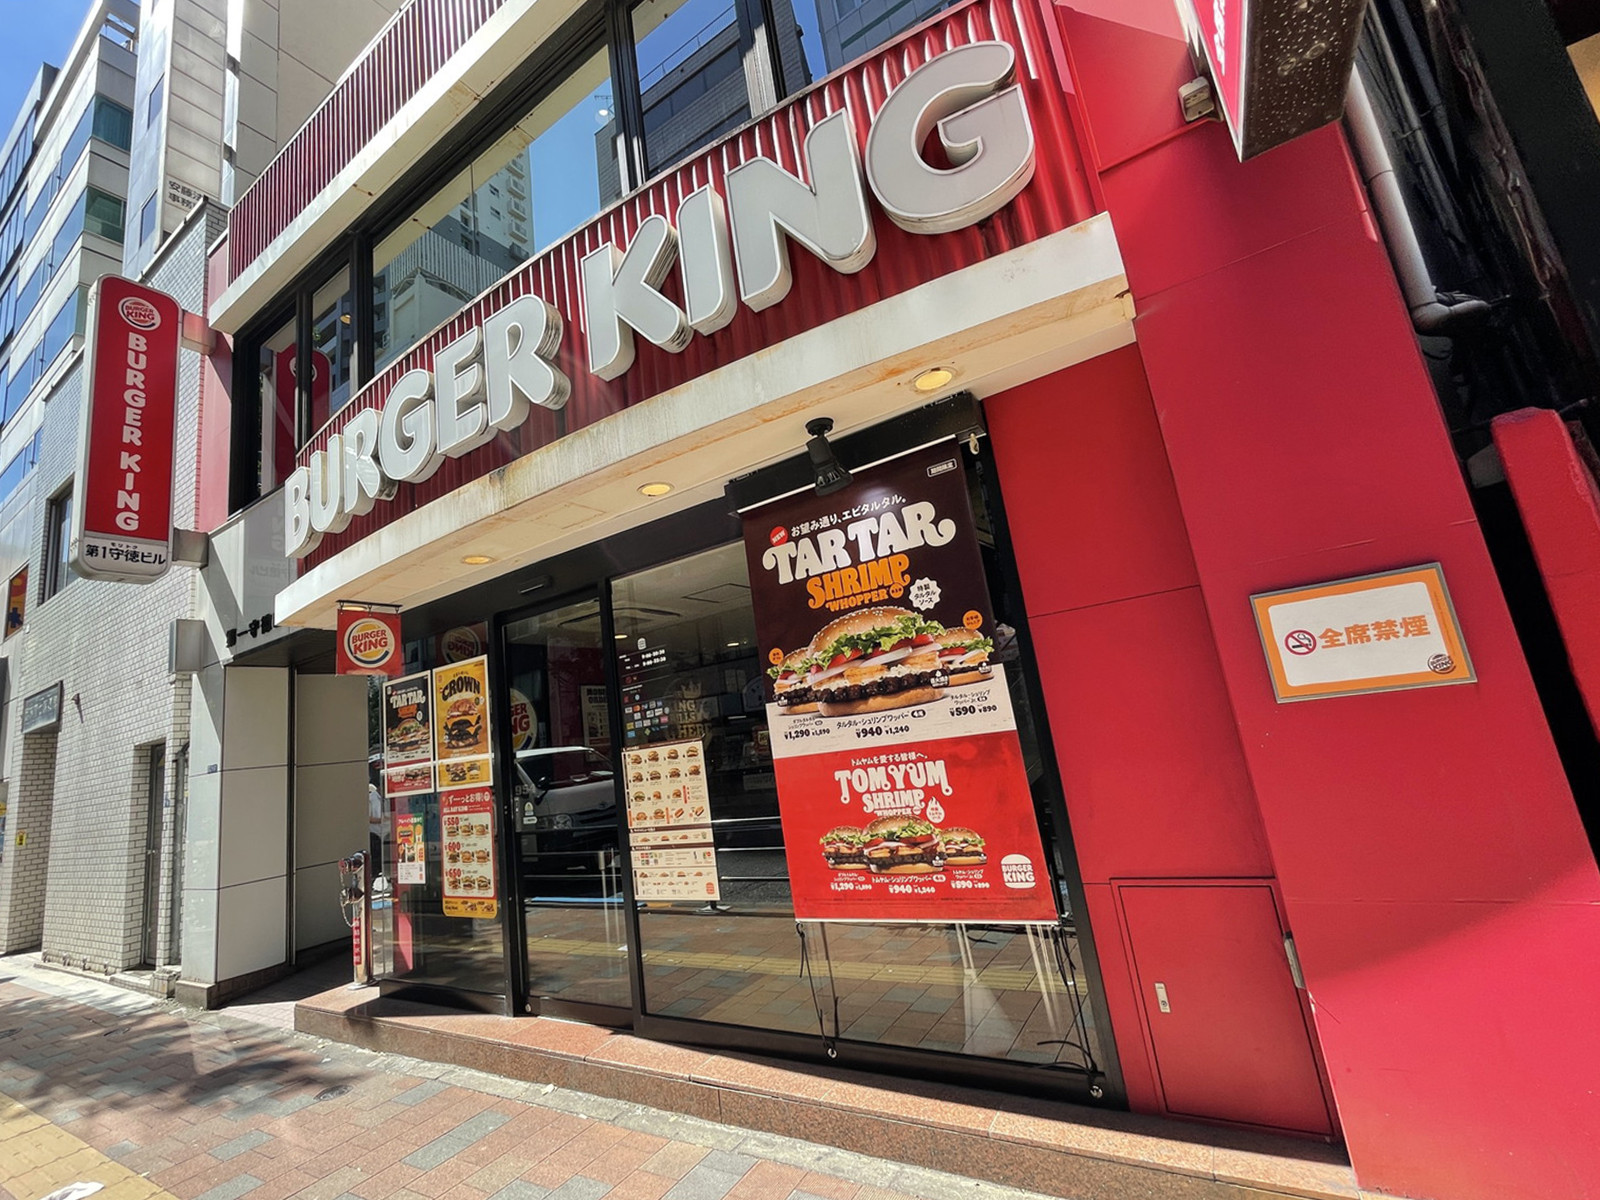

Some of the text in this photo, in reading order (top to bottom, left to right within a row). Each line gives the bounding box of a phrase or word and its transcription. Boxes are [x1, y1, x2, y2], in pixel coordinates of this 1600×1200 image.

[285, 40, 1036, 558] BURGER KING
[125, 305, 154, 314] BURGER
[126, 310, 155, 321] KING
[115, 331, 148, 531] BURGER KING
[771, 529, 786, 543] NEW
[85, 544, 166, 566] 第1守徳ビル
[806, 553, 911, 609] SHRIMP
[825, 588, 889, 612] WHOPPER
[914, 590, 936, 600] タルタル
[919, 598, 934, 606] ソース
[352, 629, 387, 645] BURGER
[1318, 614, 1431, 649] 全席禁煙
[353, 637, 388, 655] KING
[441, 676, 480, 701] CROWN
[950, 704, 997, 717] ¥590 ¥890
[784, 728, 810, 740] ¥1,290
[856, 725, 910, 738] ¥940 ¥1,240
[862, 789, 926, 813] SHRIMP
[1002, 864, 1033, 873] BURGER
[1003, 872, 1035, 882] KING
